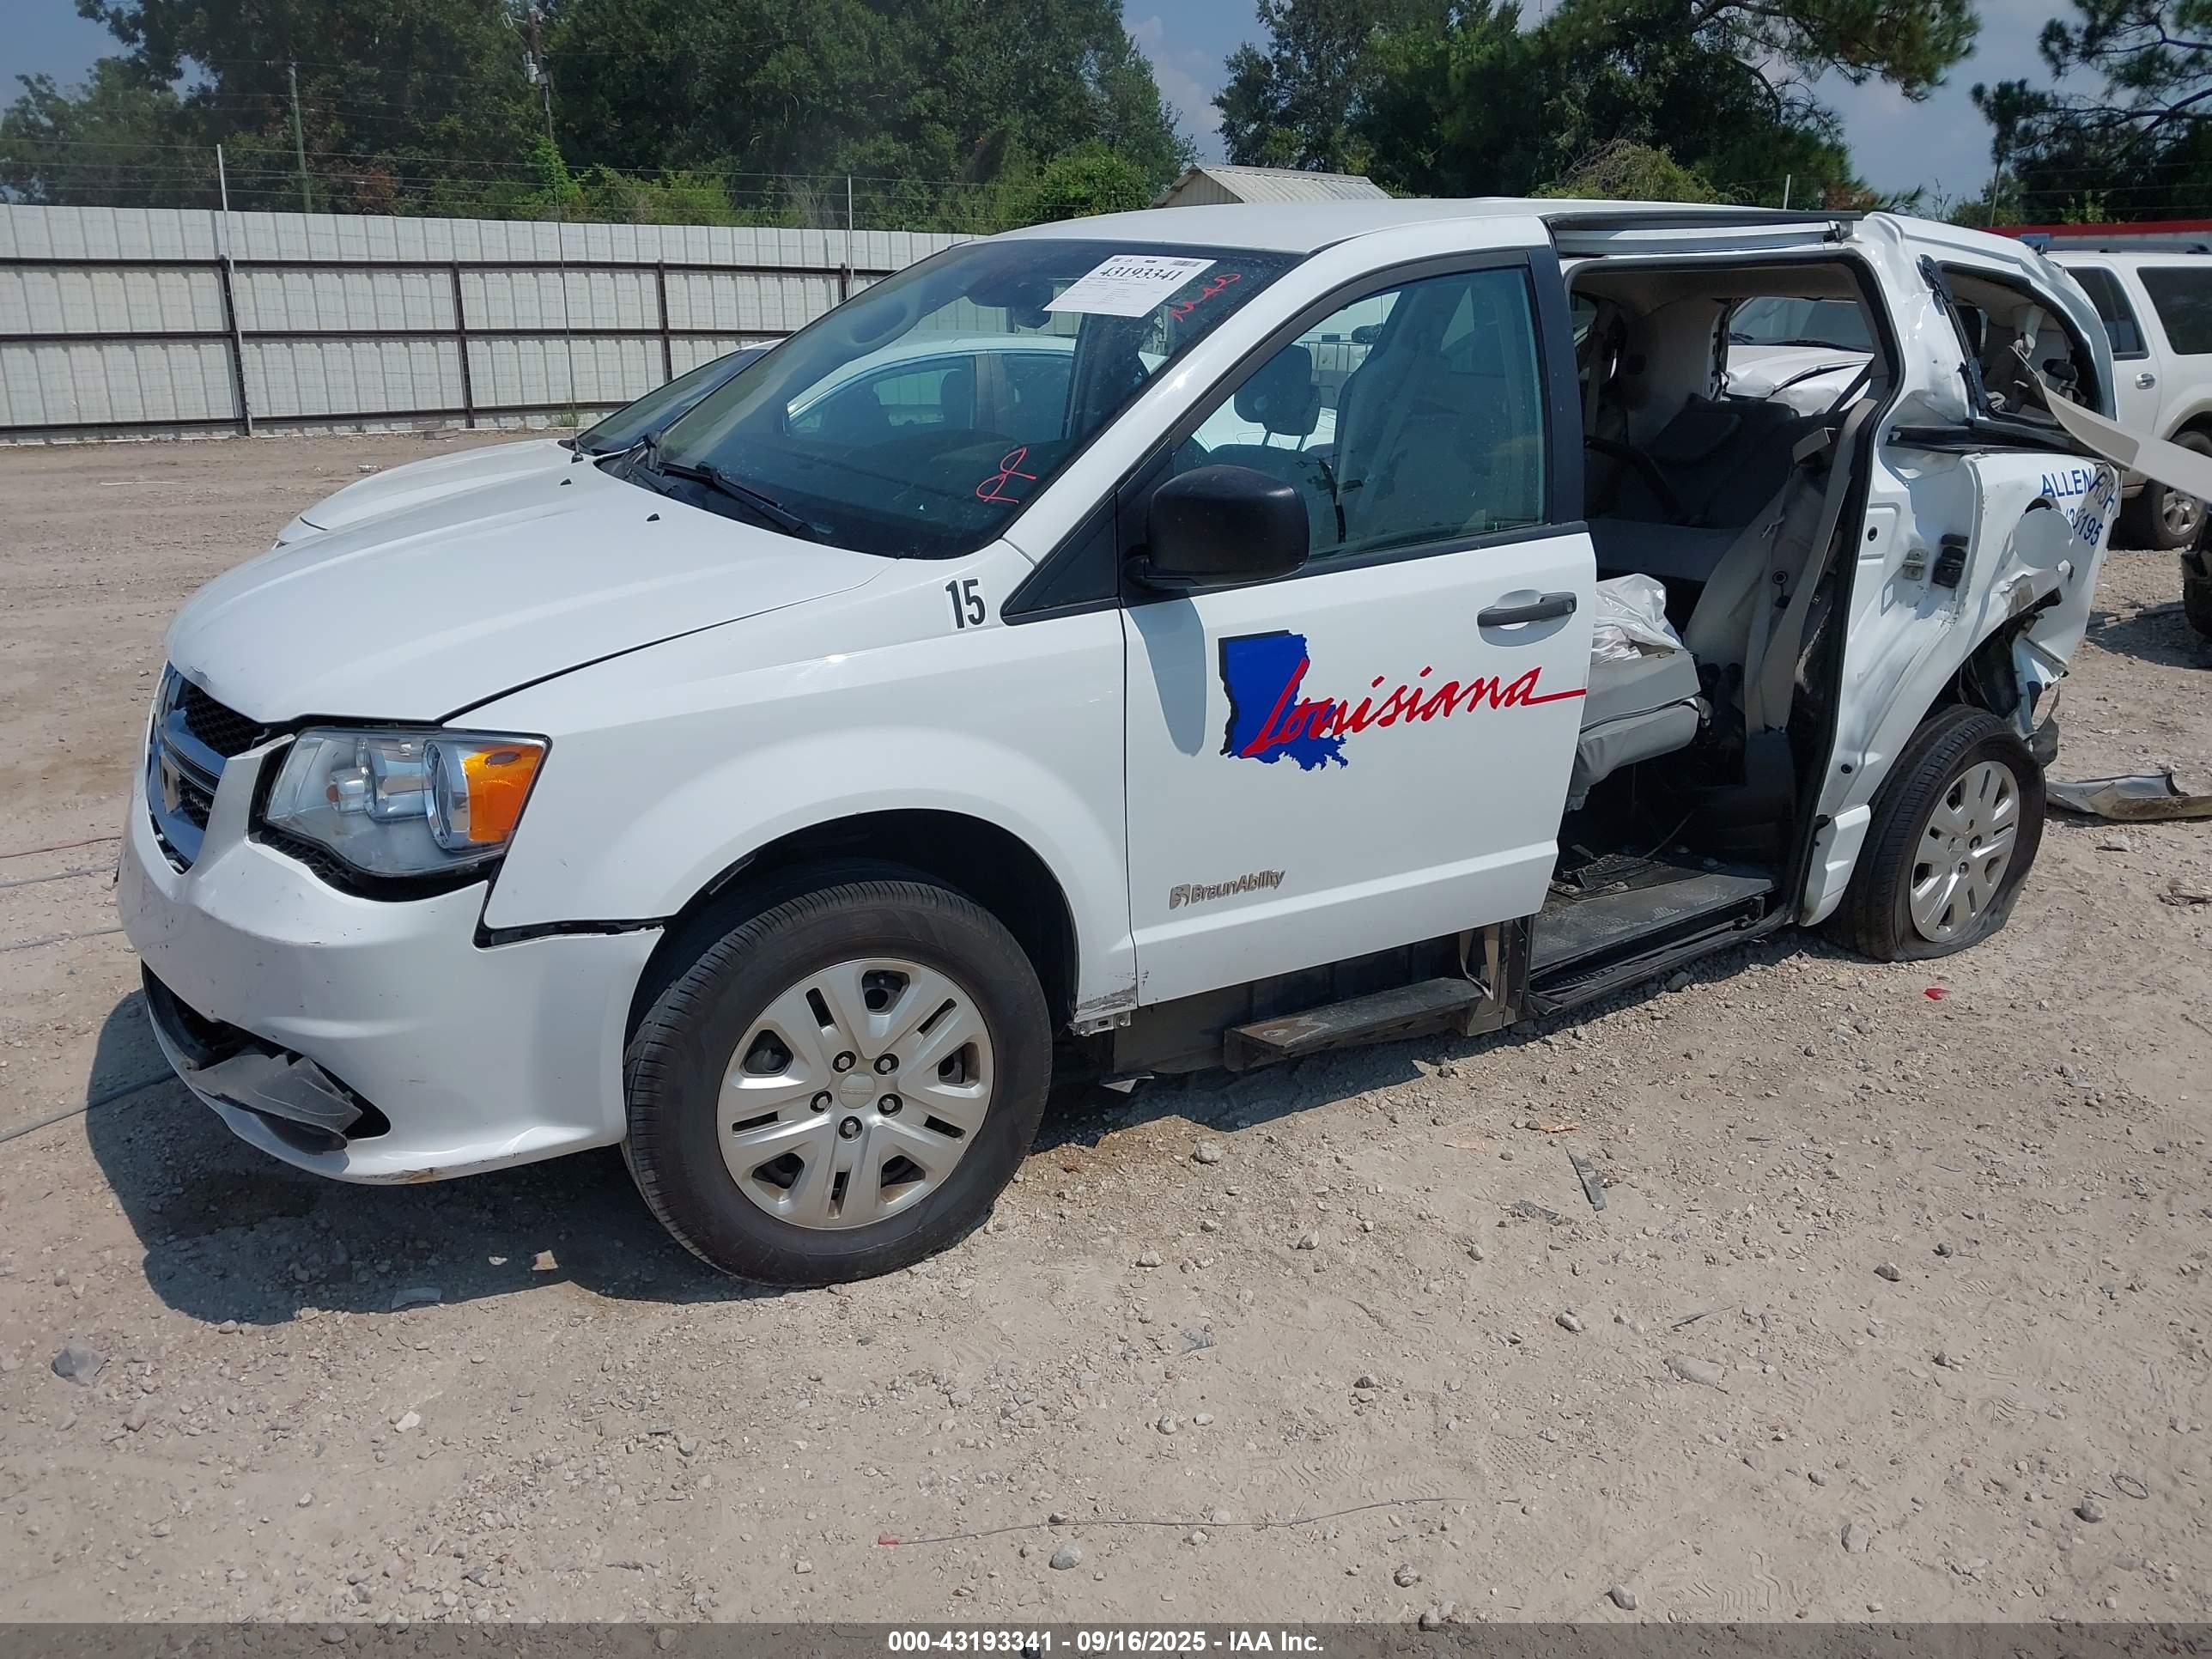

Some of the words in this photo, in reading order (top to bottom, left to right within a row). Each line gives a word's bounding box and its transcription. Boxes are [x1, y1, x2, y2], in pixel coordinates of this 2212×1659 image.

[1099, 265, 1184, 282] 43193341
[2041, 468, 2092, 498] ALLEN
[945, 578, 987, 629] 15
[1243, 657, 1587, 757] Louisiana
[1191, 869, 1285, 903] BraunAbility
